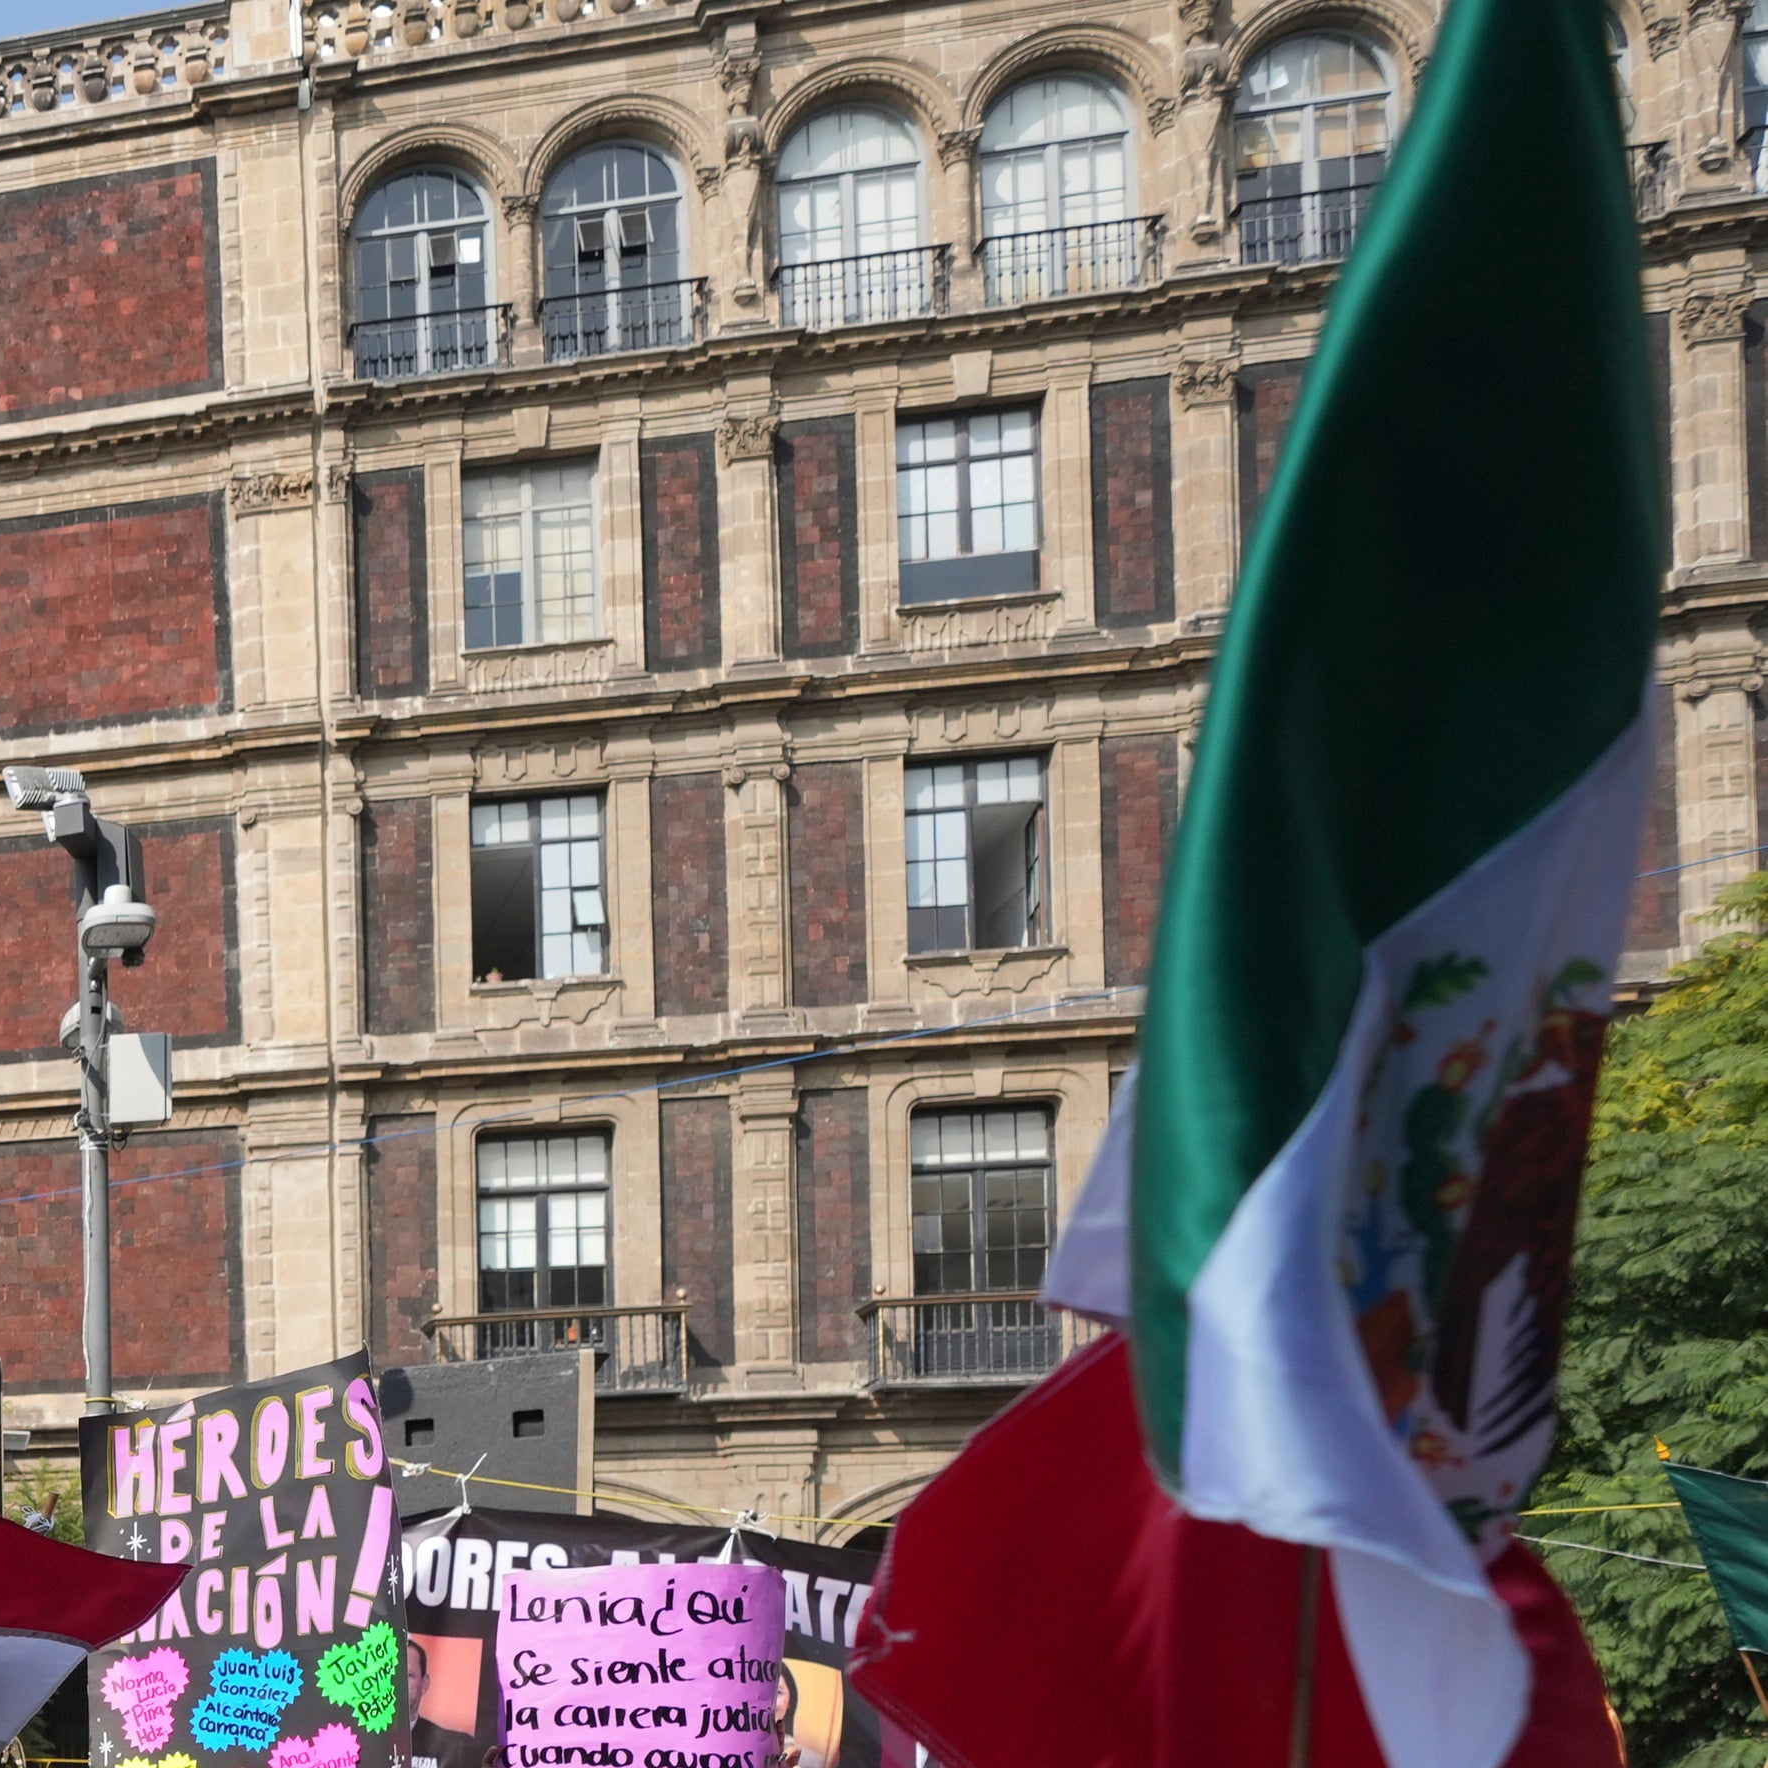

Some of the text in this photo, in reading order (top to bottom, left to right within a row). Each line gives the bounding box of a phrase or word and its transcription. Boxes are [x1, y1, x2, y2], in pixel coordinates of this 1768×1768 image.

[107, 1374, 383, 1518] HÉROES
[160, 1485, 336, 1564] DE LA
[217, 1659, 297, 1685] Juan Luis
[330, 1638, 391, 1687] Javier
[510, 1649, 553, 1690] Se
[571, 1648, 695, 1686] siente
[111, 1669, 165, 1695] Norma
[218, 1678, 290, 1703] González
[132, 1702, 165, 1727] Piña
[505, 1699, 539, 1732] la
[553, 1703, 688, 1729] carrera
